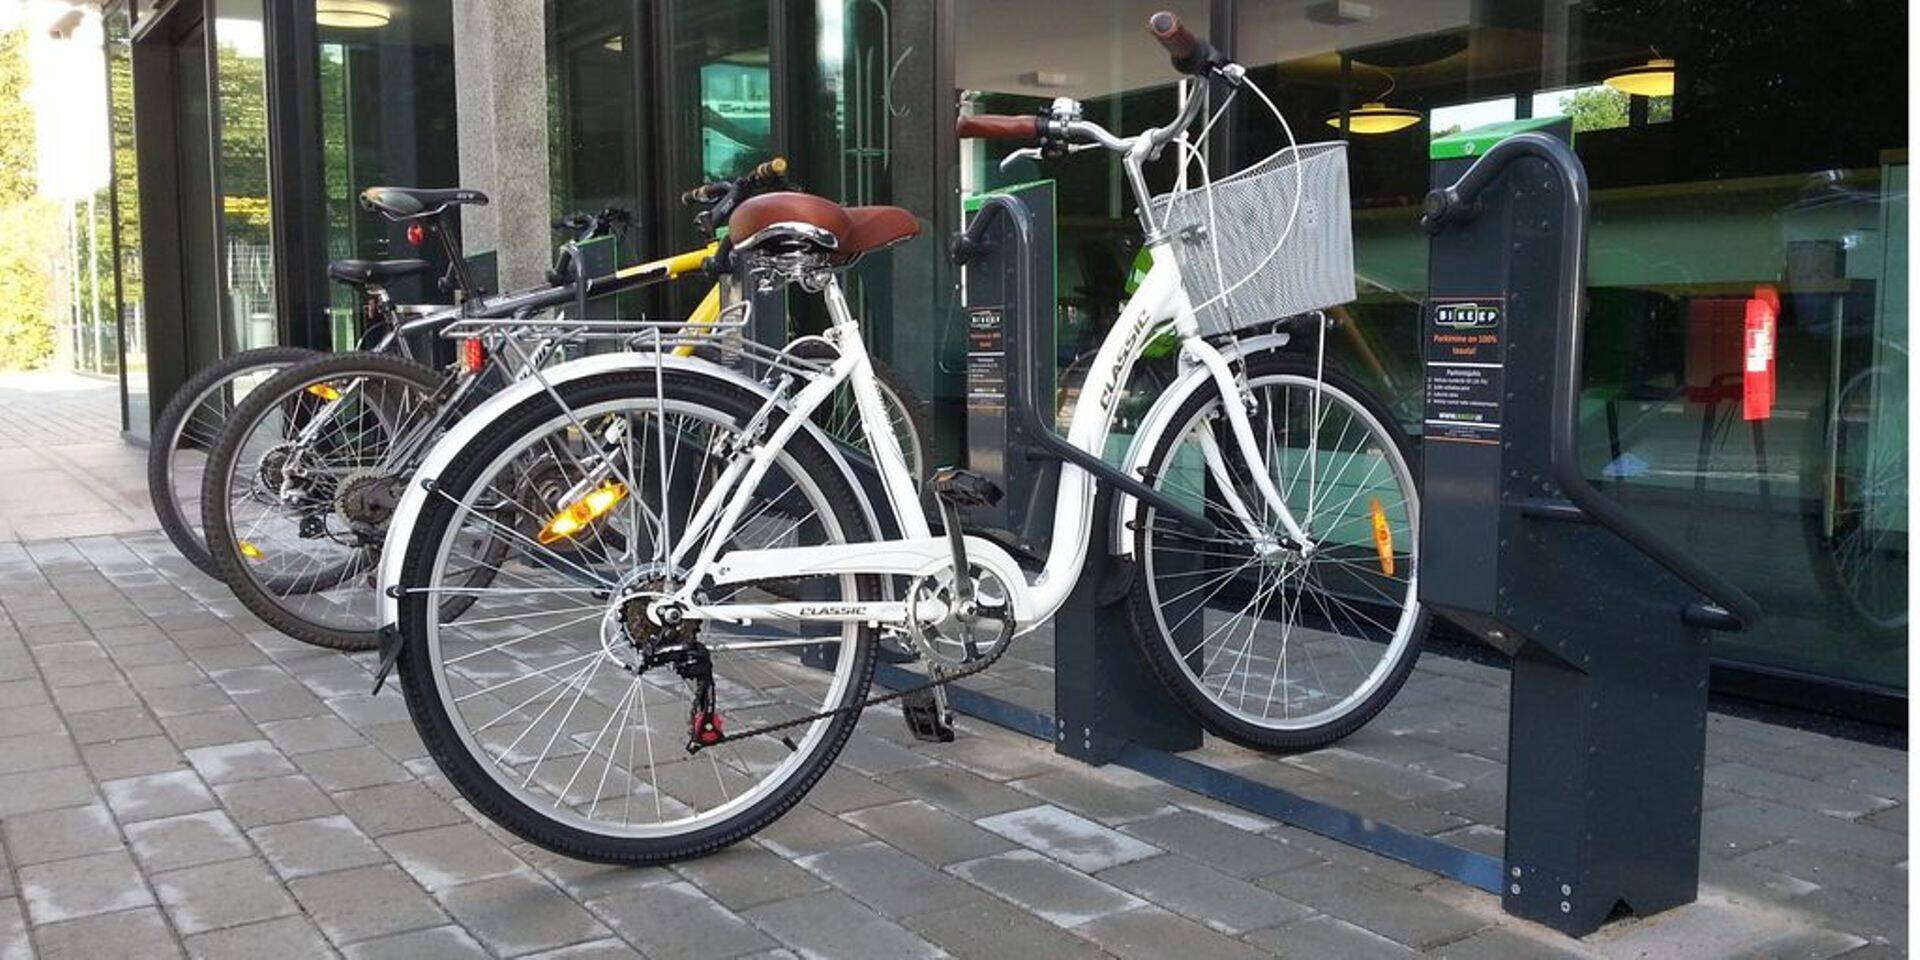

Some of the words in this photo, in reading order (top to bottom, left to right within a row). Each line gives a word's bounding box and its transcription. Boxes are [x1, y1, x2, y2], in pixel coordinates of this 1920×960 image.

[1438, 309, 1497, 323] BIKEEP
[1478, 334, 1498, 345] 100%
[1100, 308, 1151, 410] CLASSIC
[799, 607, 867, 616] CLASSIC
